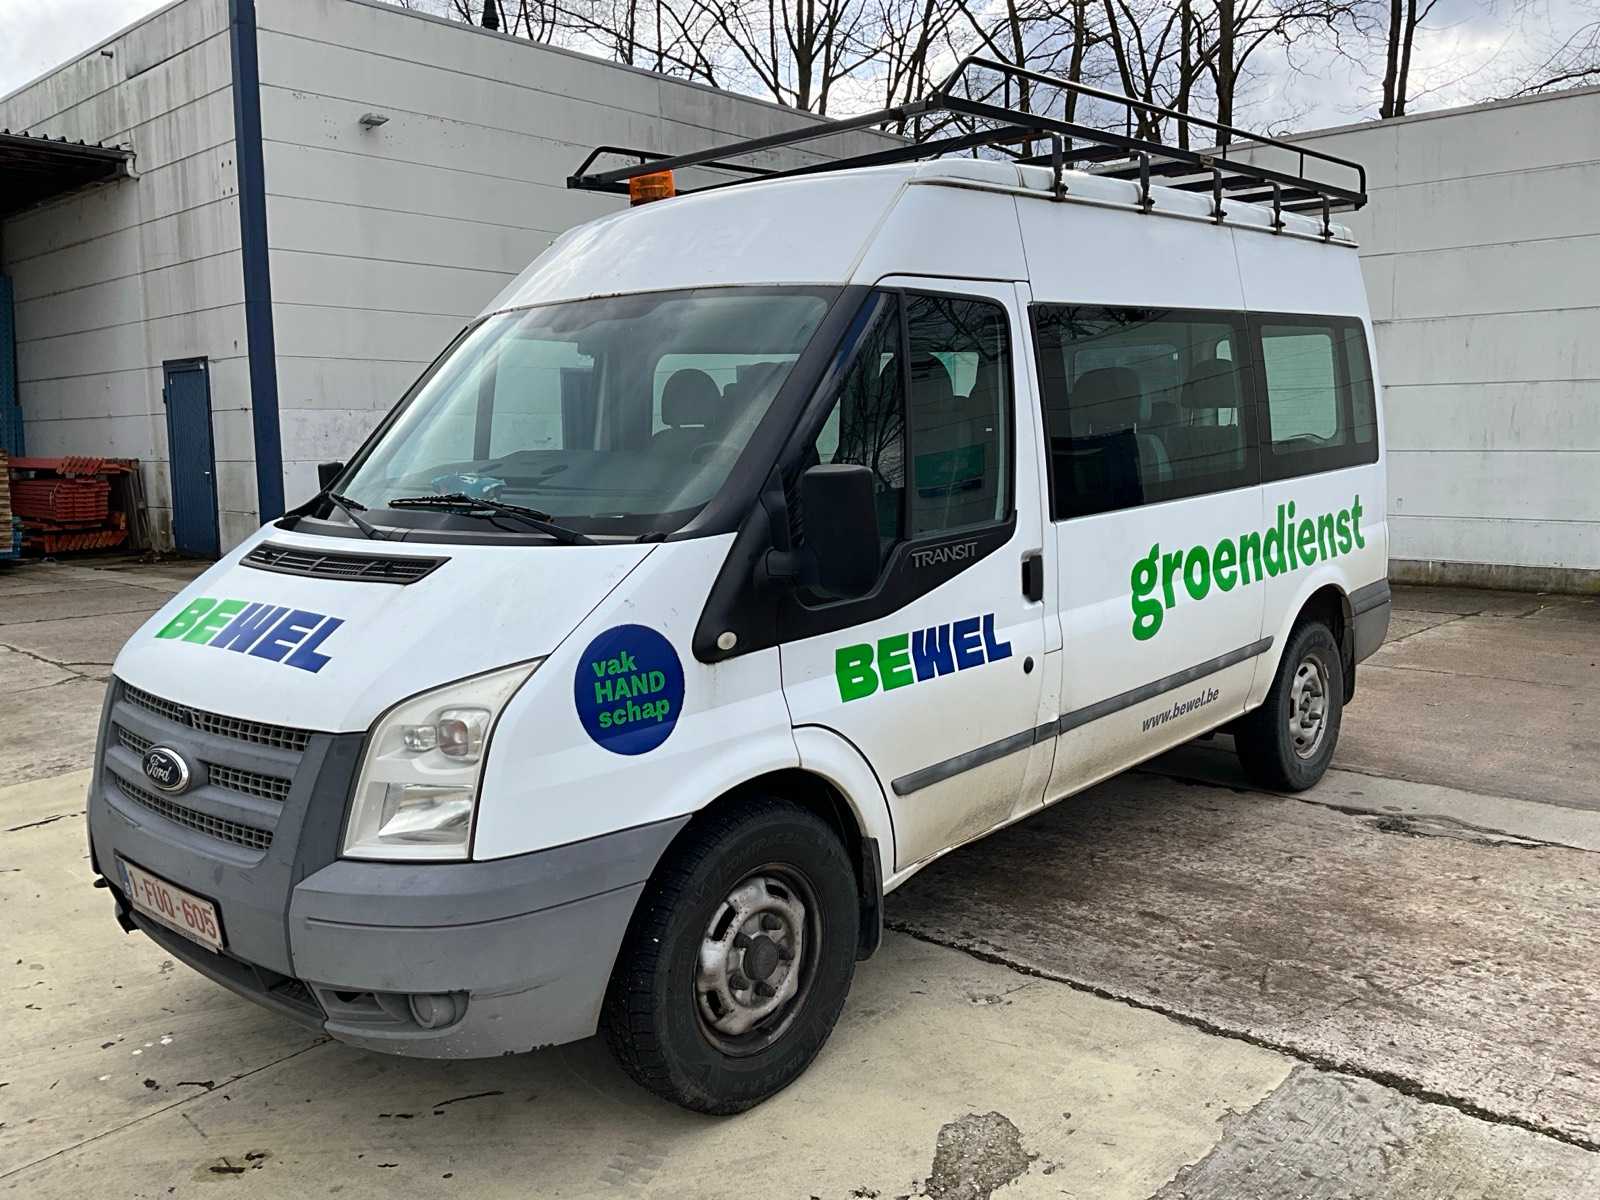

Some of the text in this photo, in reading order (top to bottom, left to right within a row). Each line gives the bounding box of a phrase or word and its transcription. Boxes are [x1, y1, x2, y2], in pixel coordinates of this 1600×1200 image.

[912, 542, 978, 568] TRANSIT
[1131, 494, 1365, 641] groendienst
[153, 598, 346, 674] BEWEL
[592, 651, 637, 677] vak
[836, 613, 1012, 703] BEWEL
[594, 671, 665, 704] HAND
[599, 699, 669, 728] schap
[1142, 687, 1219, 733] www.bewel.be
[146, 753, 172, 783] Ford
